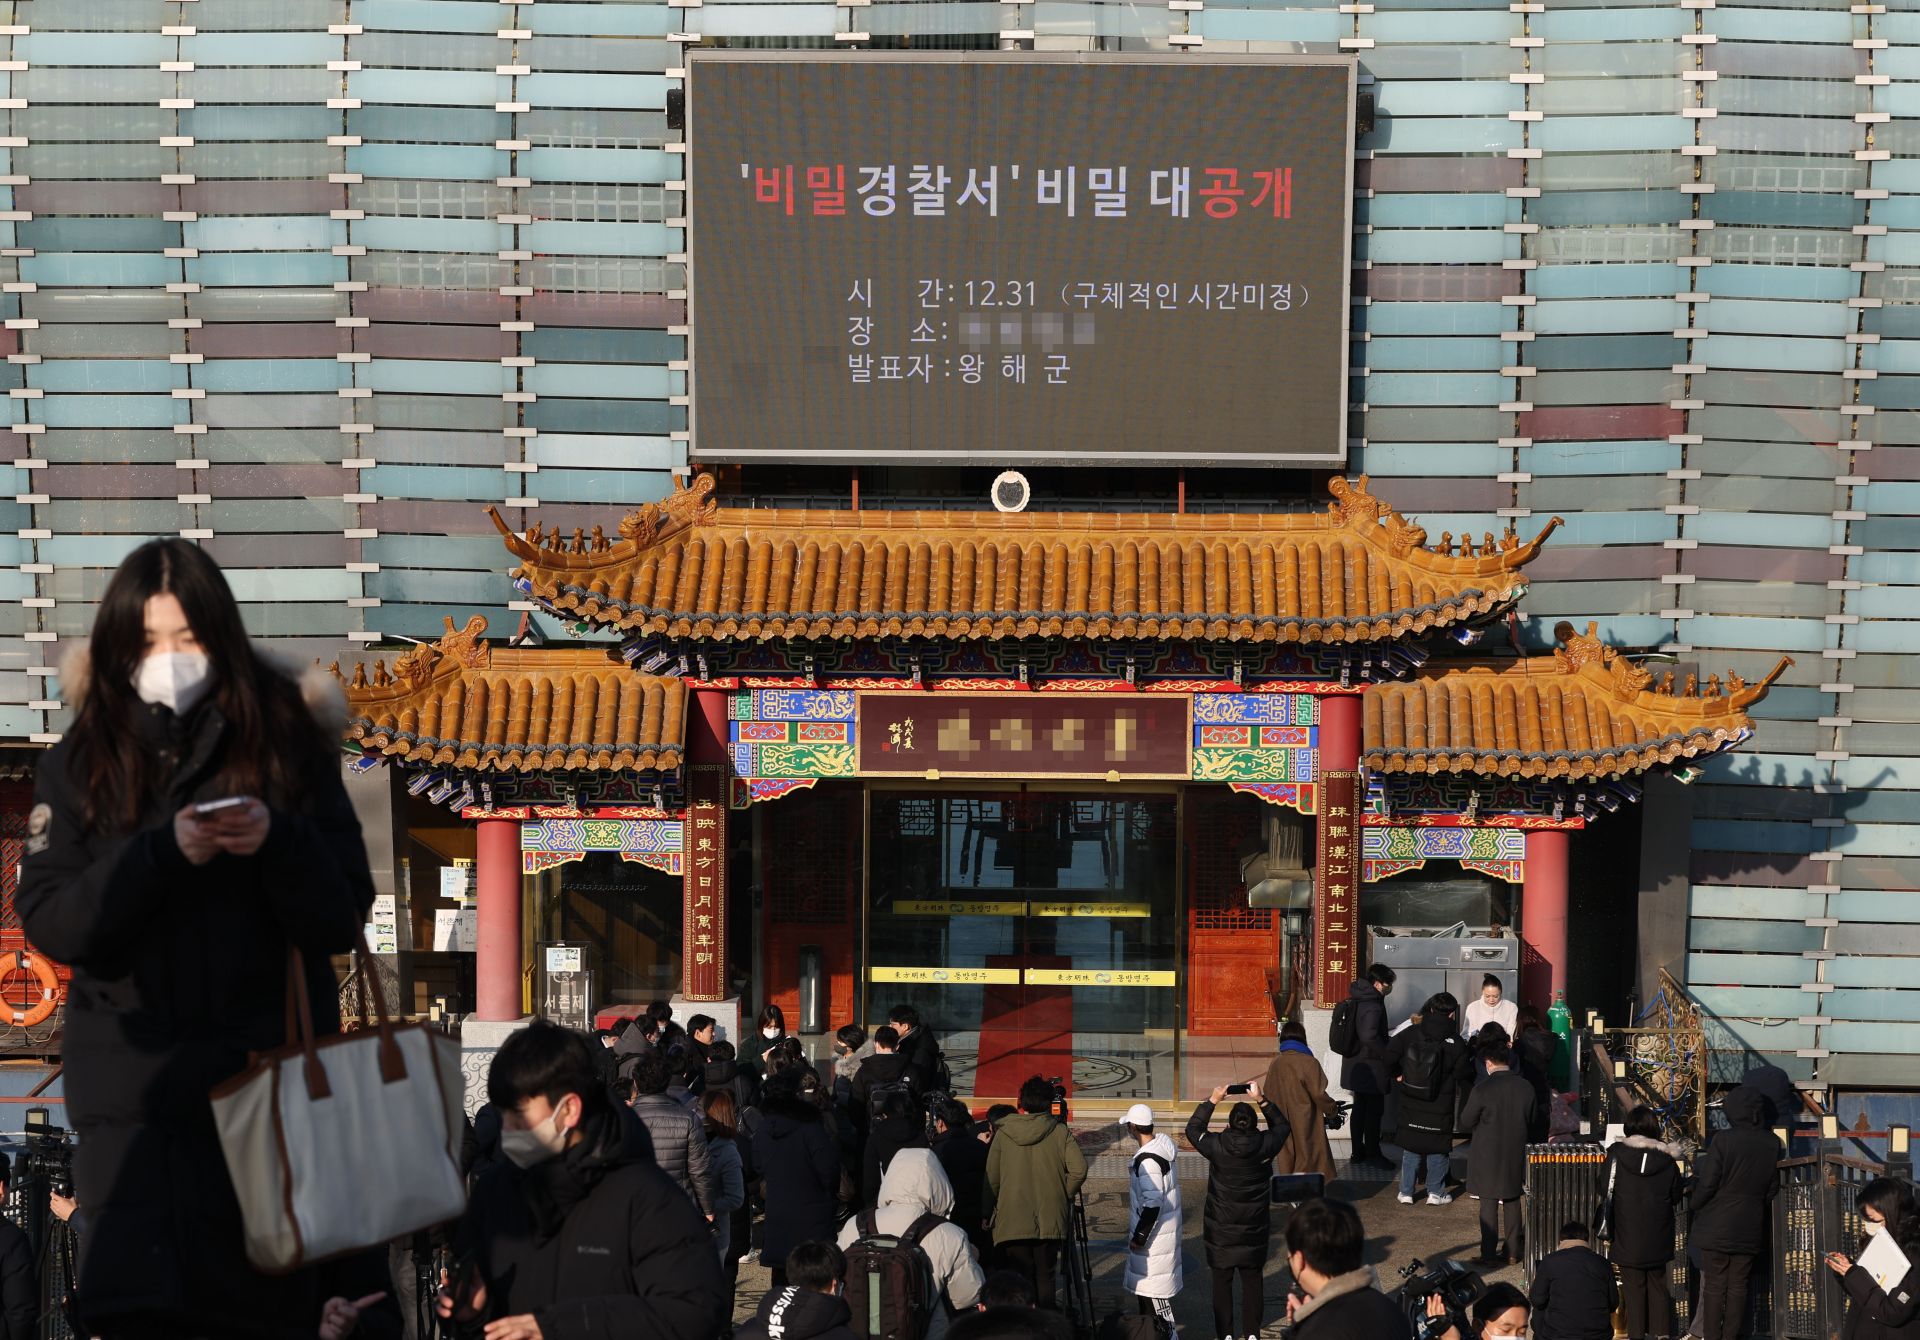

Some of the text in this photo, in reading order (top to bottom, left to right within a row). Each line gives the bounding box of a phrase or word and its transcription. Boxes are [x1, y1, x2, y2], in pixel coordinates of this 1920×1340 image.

[741, 163, 1292, 219] '비밀경찰서' 비밀 대공개
[847, 278, 872, 309] 시
[964, 280, 1035, 307] 12.31
[848, 316, 874, 346] 장
